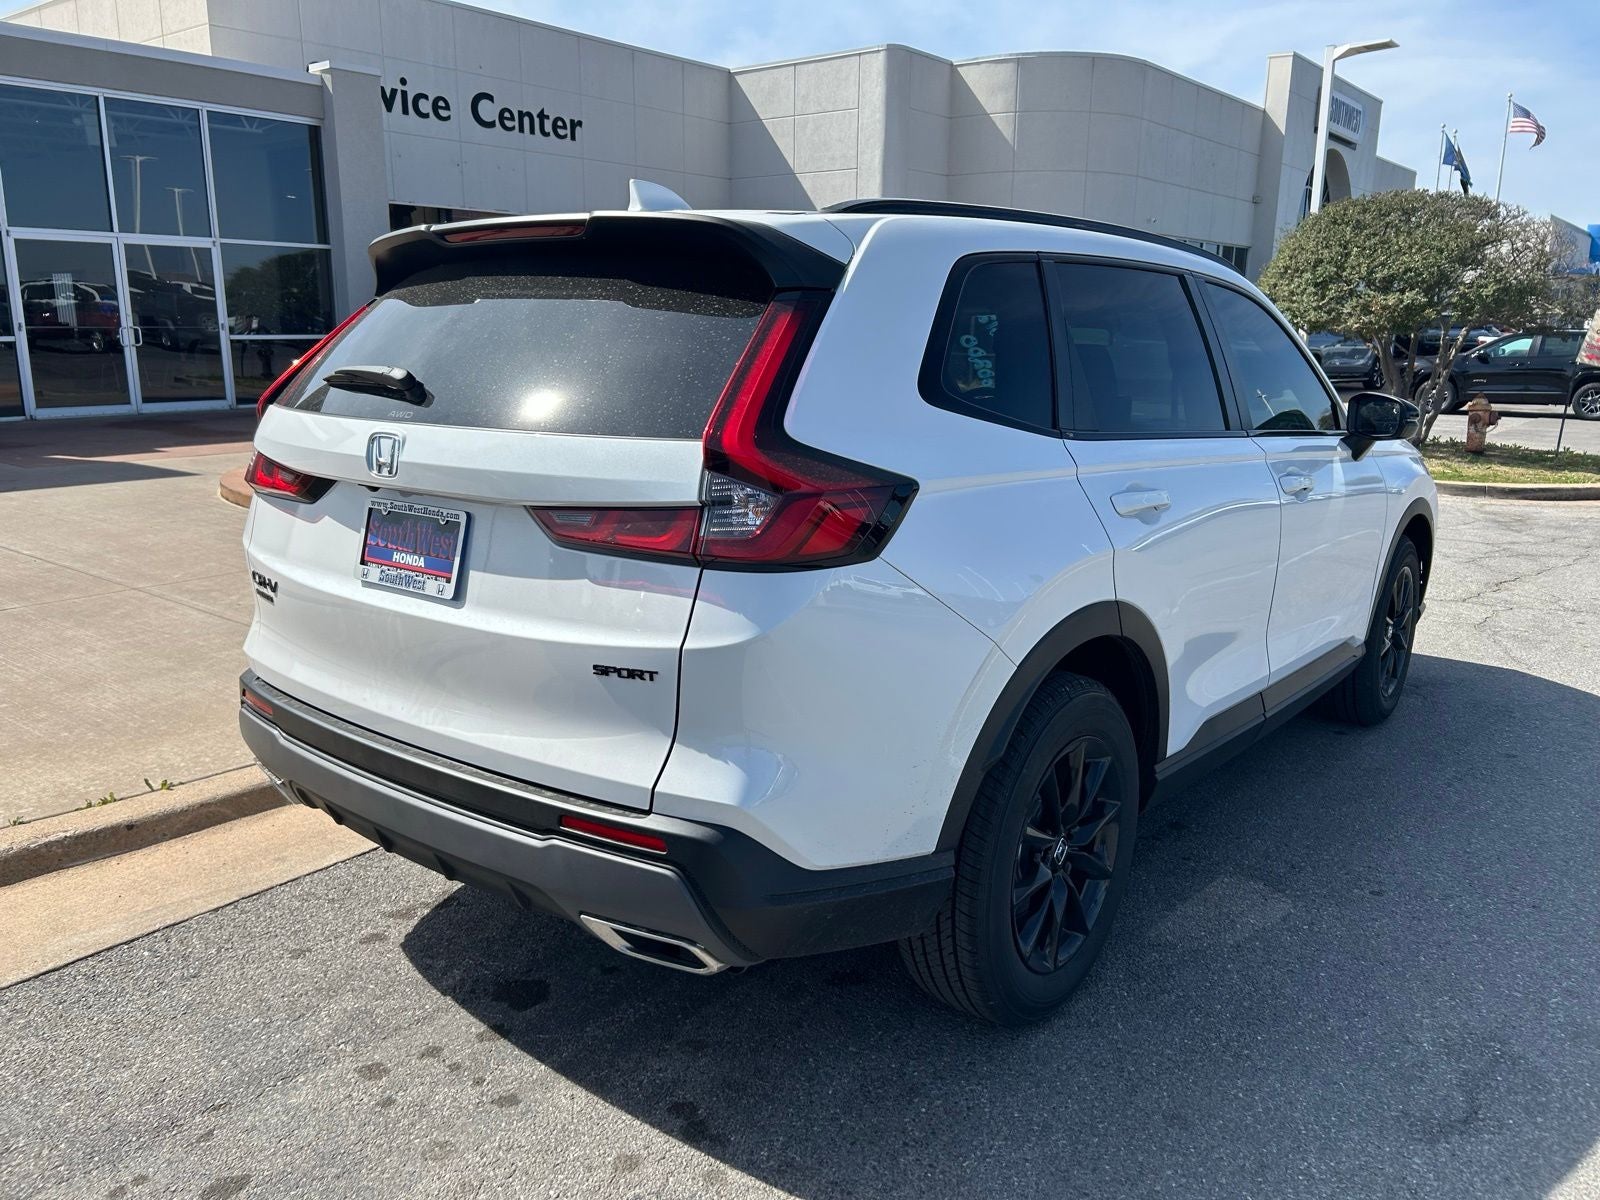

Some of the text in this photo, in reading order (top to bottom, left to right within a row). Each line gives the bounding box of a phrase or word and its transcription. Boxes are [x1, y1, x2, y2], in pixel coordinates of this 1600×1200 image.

[470, 92, 583, 142] Center
[387, 410, 414, 419] AWD
[392, 551, 425, 568] HONDA
[592, 664, 659, 682] SPORT
